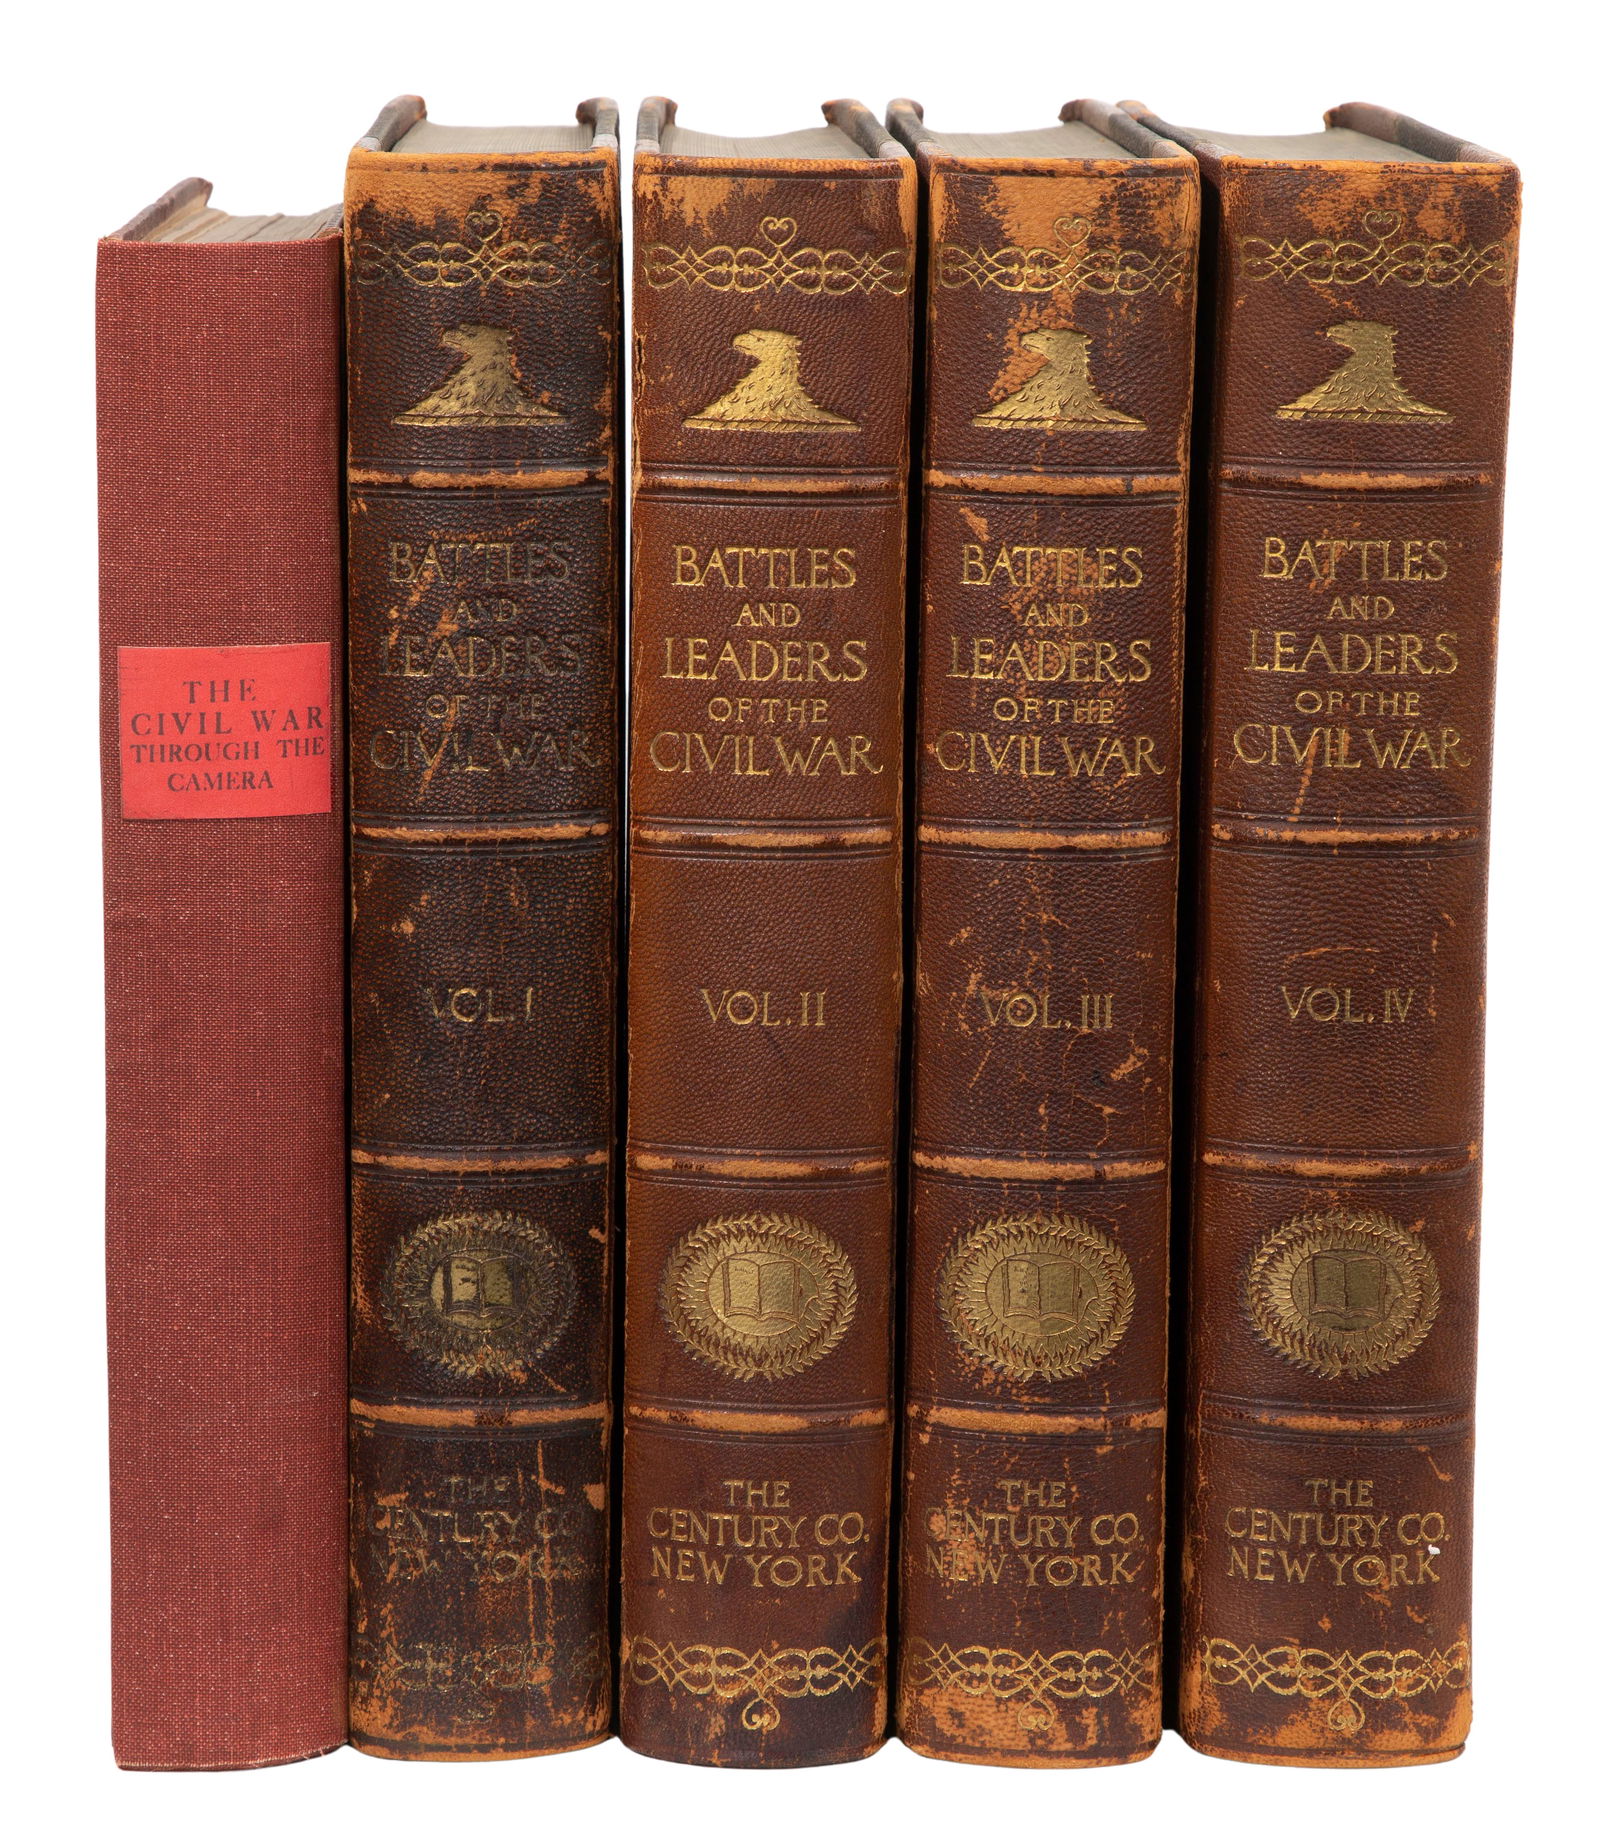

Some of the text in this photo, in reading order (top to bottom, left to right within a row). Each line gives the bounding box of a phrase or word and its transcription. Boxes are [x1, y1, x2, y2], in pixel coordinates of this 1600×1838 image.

[388, 541, 571, 584] BATTLES
[671, 544, 857, 588] BATTLES
[960, 544, 1143, 588] BATTLES
[1259, 536, 1449, 581] BATTLES
[732, 602, 801, 627] AND
[1022, 602, 1090, 627] AND
[1327, 595, 1395, 620] AND
[660, 636, 868, 682] LEADERS
[946, 635, 1152, 682] LEADERS
[1244, 629, 1459, 675] LEADERS
[183, 678, 257, 704] THE
[708, 697, 828, 724] OF THE
[993, 697, 1115, 724] OF THE
[1295, 690, 1421, 716] OF THE
[130, 706, 324, 736] CIVIL WAR
[130, 736, 325, 764] THROUGH THE
[650, 731, 884, 776] CIVIL WAR
[936, 730, 1167, 777] CIVIL WAR
[1233, 723, 1472, 770] CIVIL WAR
[167, 770, 274, 792] CAMERA
[700, 988, 828, 1026] VOL. II
[980, 992, 1114, 1029] VOL. III
[1280, 985, 1416, 1023] VOL. IV
[723, 1479, 791, 1508] THE
[999, 1479, 1067, 1508] THE
[1305, 1478, 1374, 1507] THE
[647, 1507, 870, 1548] CENTURY CO.
[924, 1507, 1145, 1548] CENTURY CO.
[1225, 1507, 1450, 1548] CENTURY CO.
[650, 1546, 862, 1588] NEW YORK
[926, 1544, 1135, 1587] NEW YORK
[1226, 1546, 1441, 1587] NEW YORK
